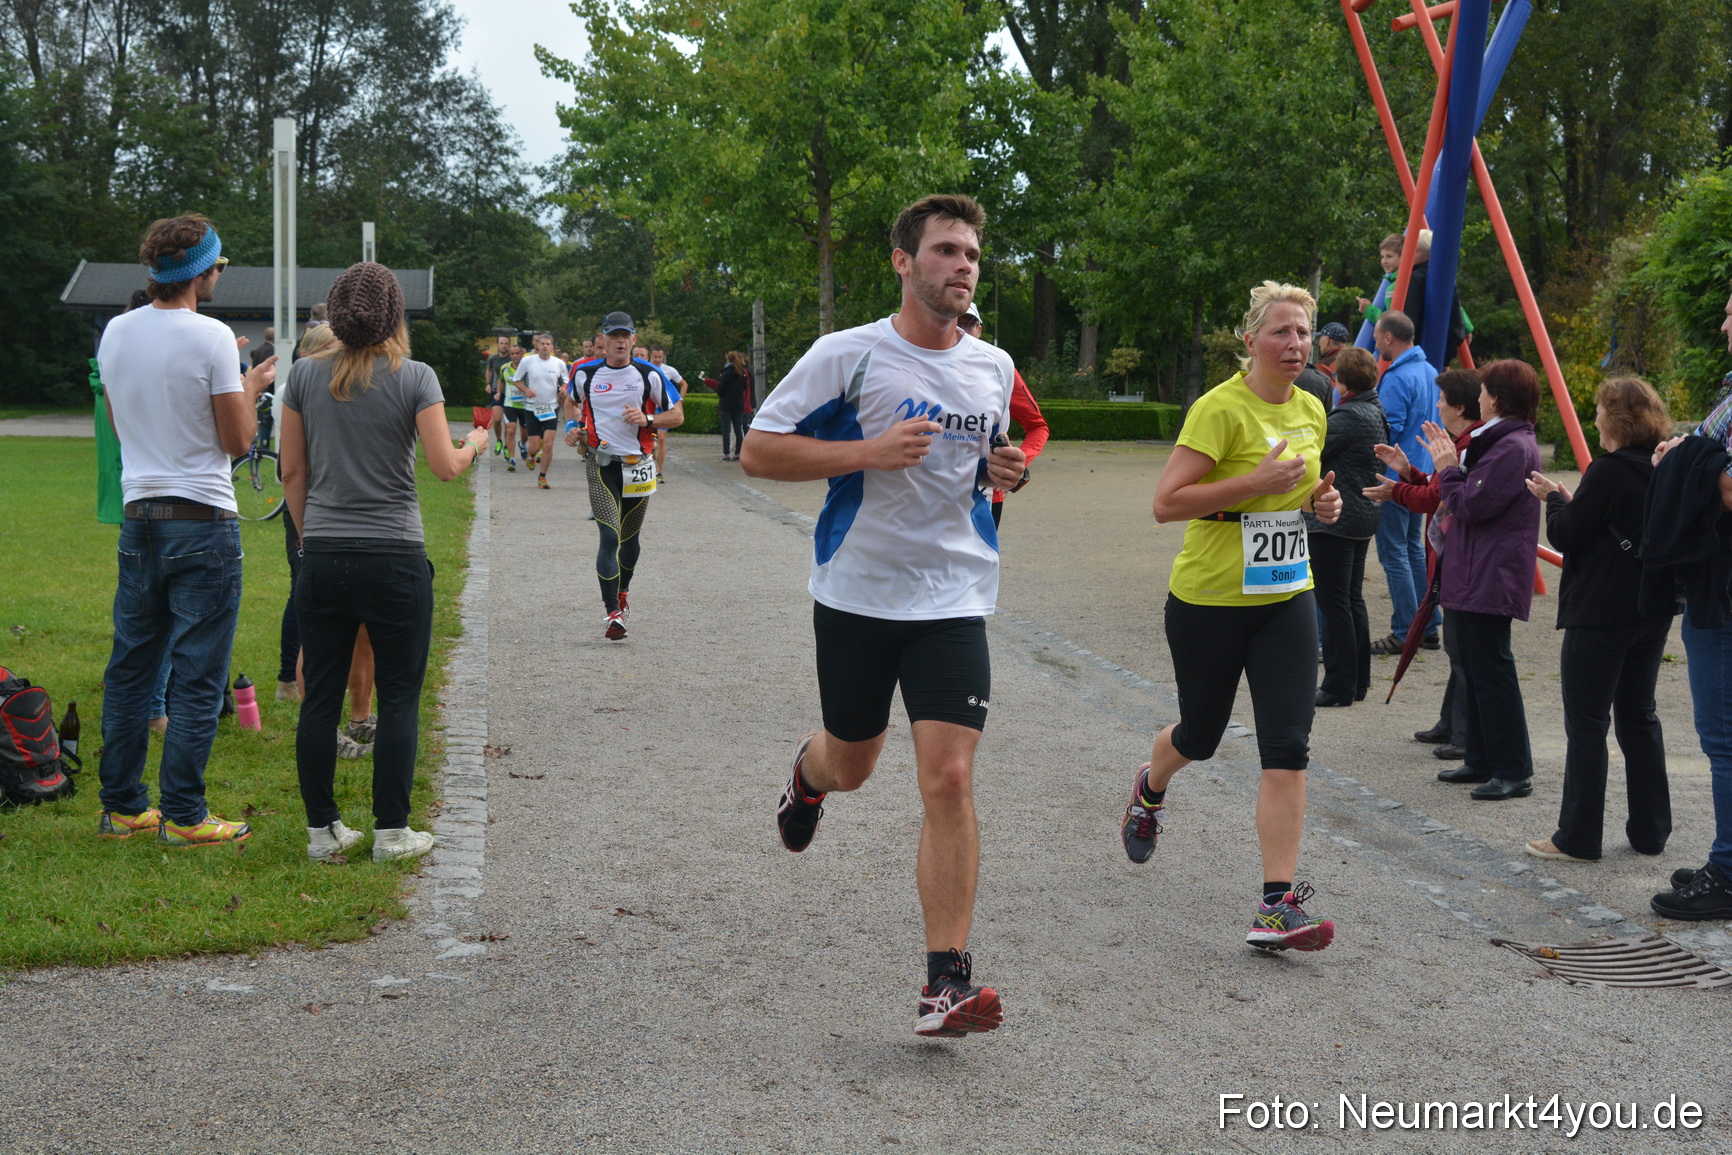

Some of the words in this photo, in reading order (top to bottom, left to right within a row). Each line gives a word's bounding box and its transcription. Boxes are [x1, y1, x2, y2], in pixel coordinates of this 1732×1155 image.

[942, 432, 965, 441] Mein
[1243, 520, 1273, 528] PARTL
[1252, 528, 1306, 562] 2076
